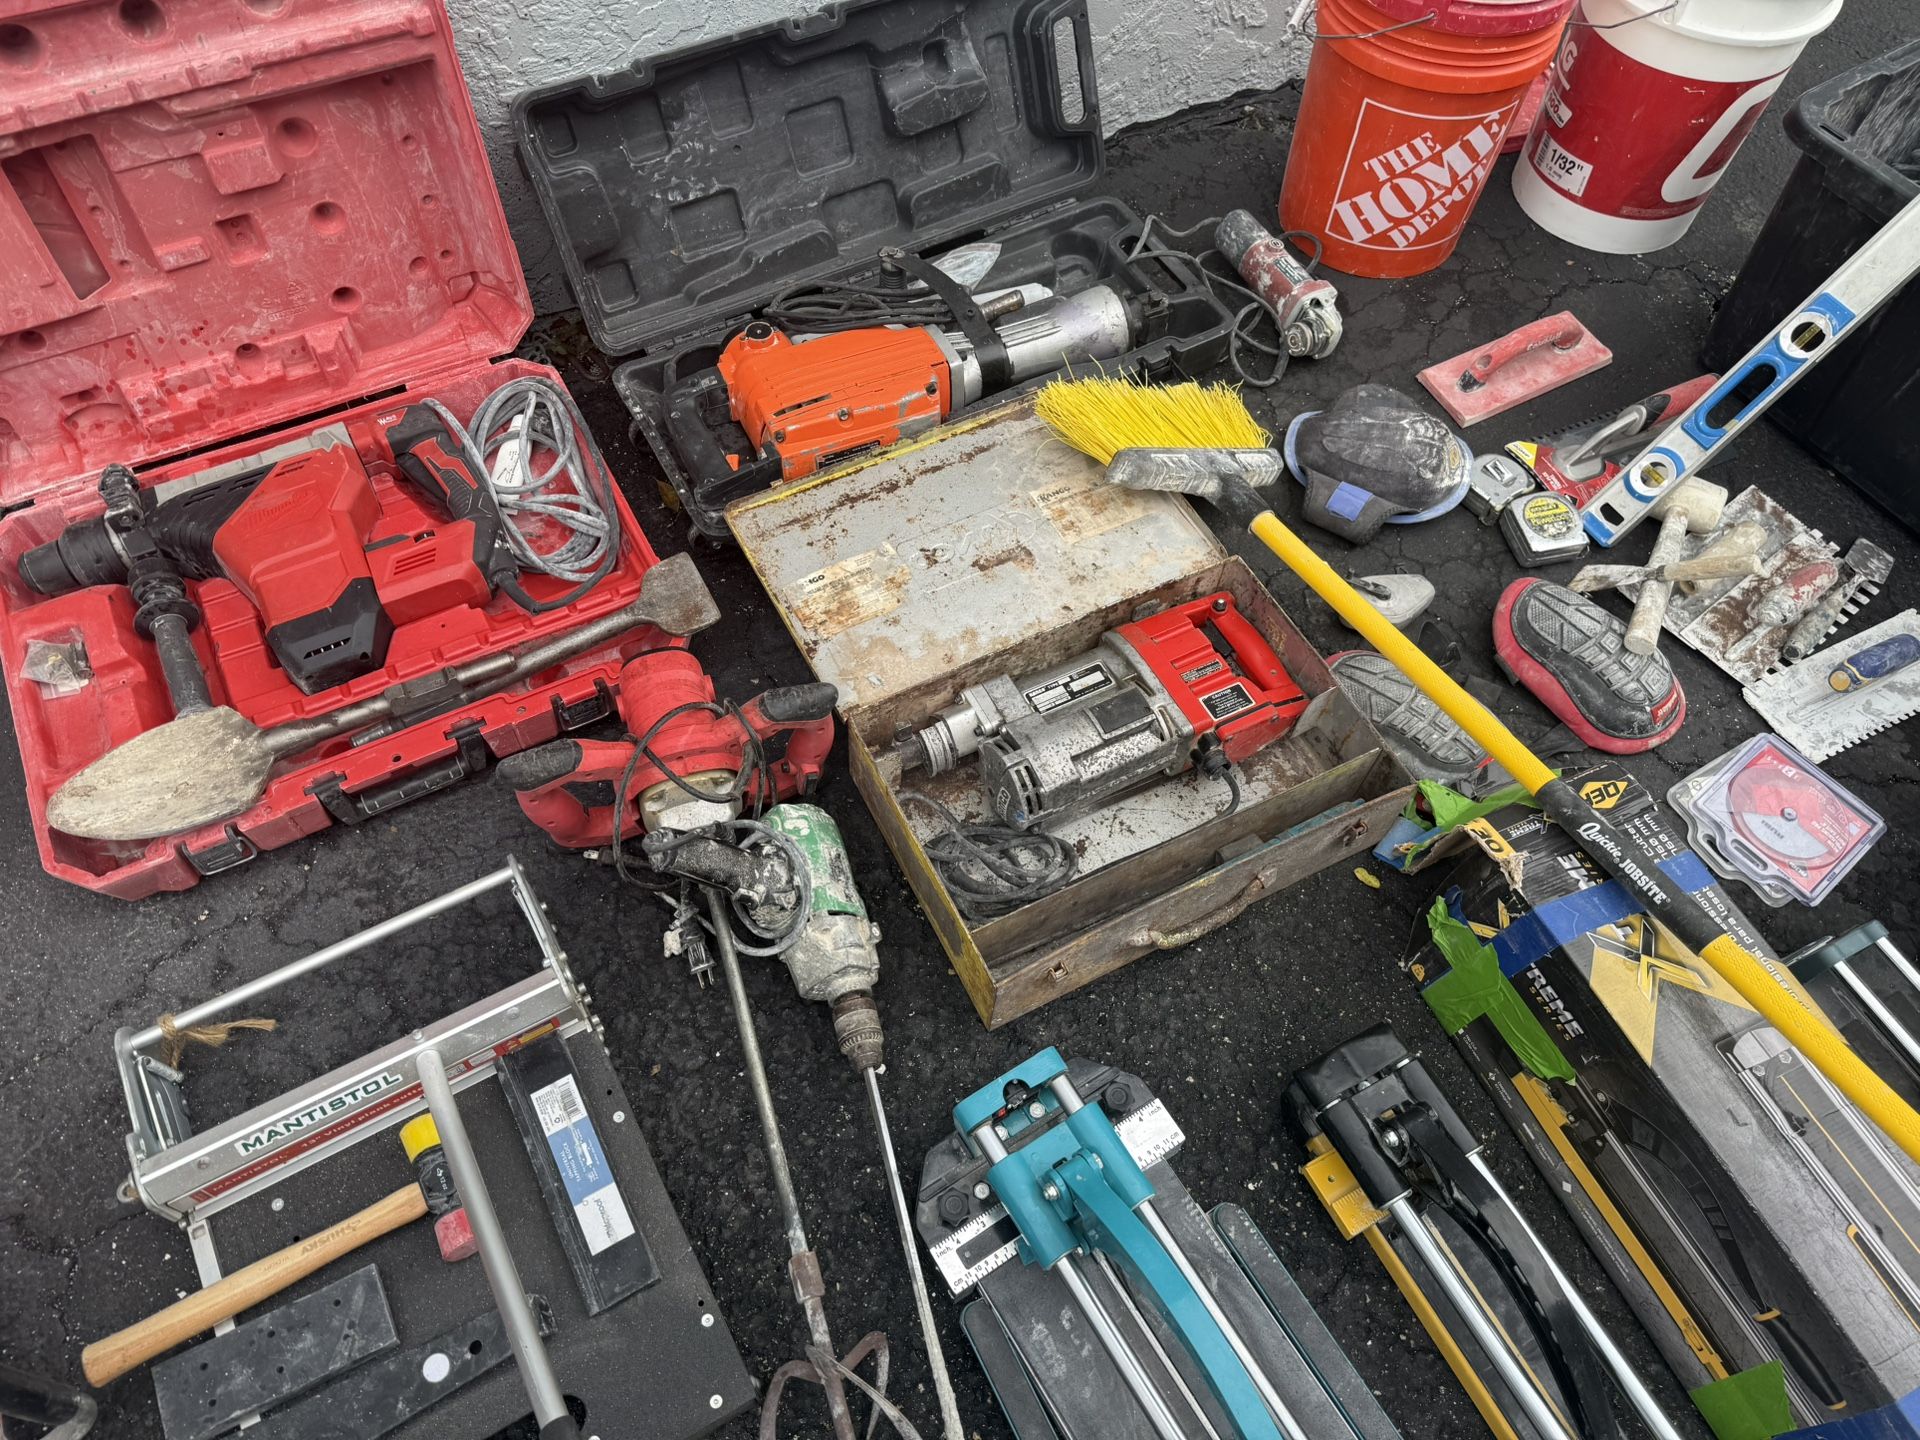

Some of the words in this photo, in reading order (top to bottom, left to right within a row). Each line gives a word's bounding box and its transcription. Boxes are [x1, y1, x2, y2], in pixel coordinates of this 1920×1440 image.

[1362, 131, 1442, 183] THE
[1550, 148, 1584, 176] 1/32"
[1335, 112, 1506, 243] HOME
[1039, 486, 1071, 503] KANGO
[1633, 817, 1651, 836] mm
[1643, 813, 1660, 832] mm
[1576, 822, 1622, 860] Quickie
[1624, 822, 1655, 857] Cutter
[1727, 917, 1752, 944] para
[1527, 962, 1586, 1039] REME
[1528, 985, 1572, 1041] SERIES
[241, 1074, 401, 1153] MANTISTOL
[356, 1102, 391, 1125] plank
[393, 1086, 424, 1104] cutte
[1148, 1105, 1162, 1117] inch
[1170, 1131, 1180, 1140] cm
[439, 1176, 446, 1185] 12
[980, 1220, 987, 1228] 3
[301, 1225, 349, 1256] HUSKY
[953, 1278, 964, 1287] cm
[964, 1272, 973, 1280] 11
[974, 1265, 983, 1273] 10
